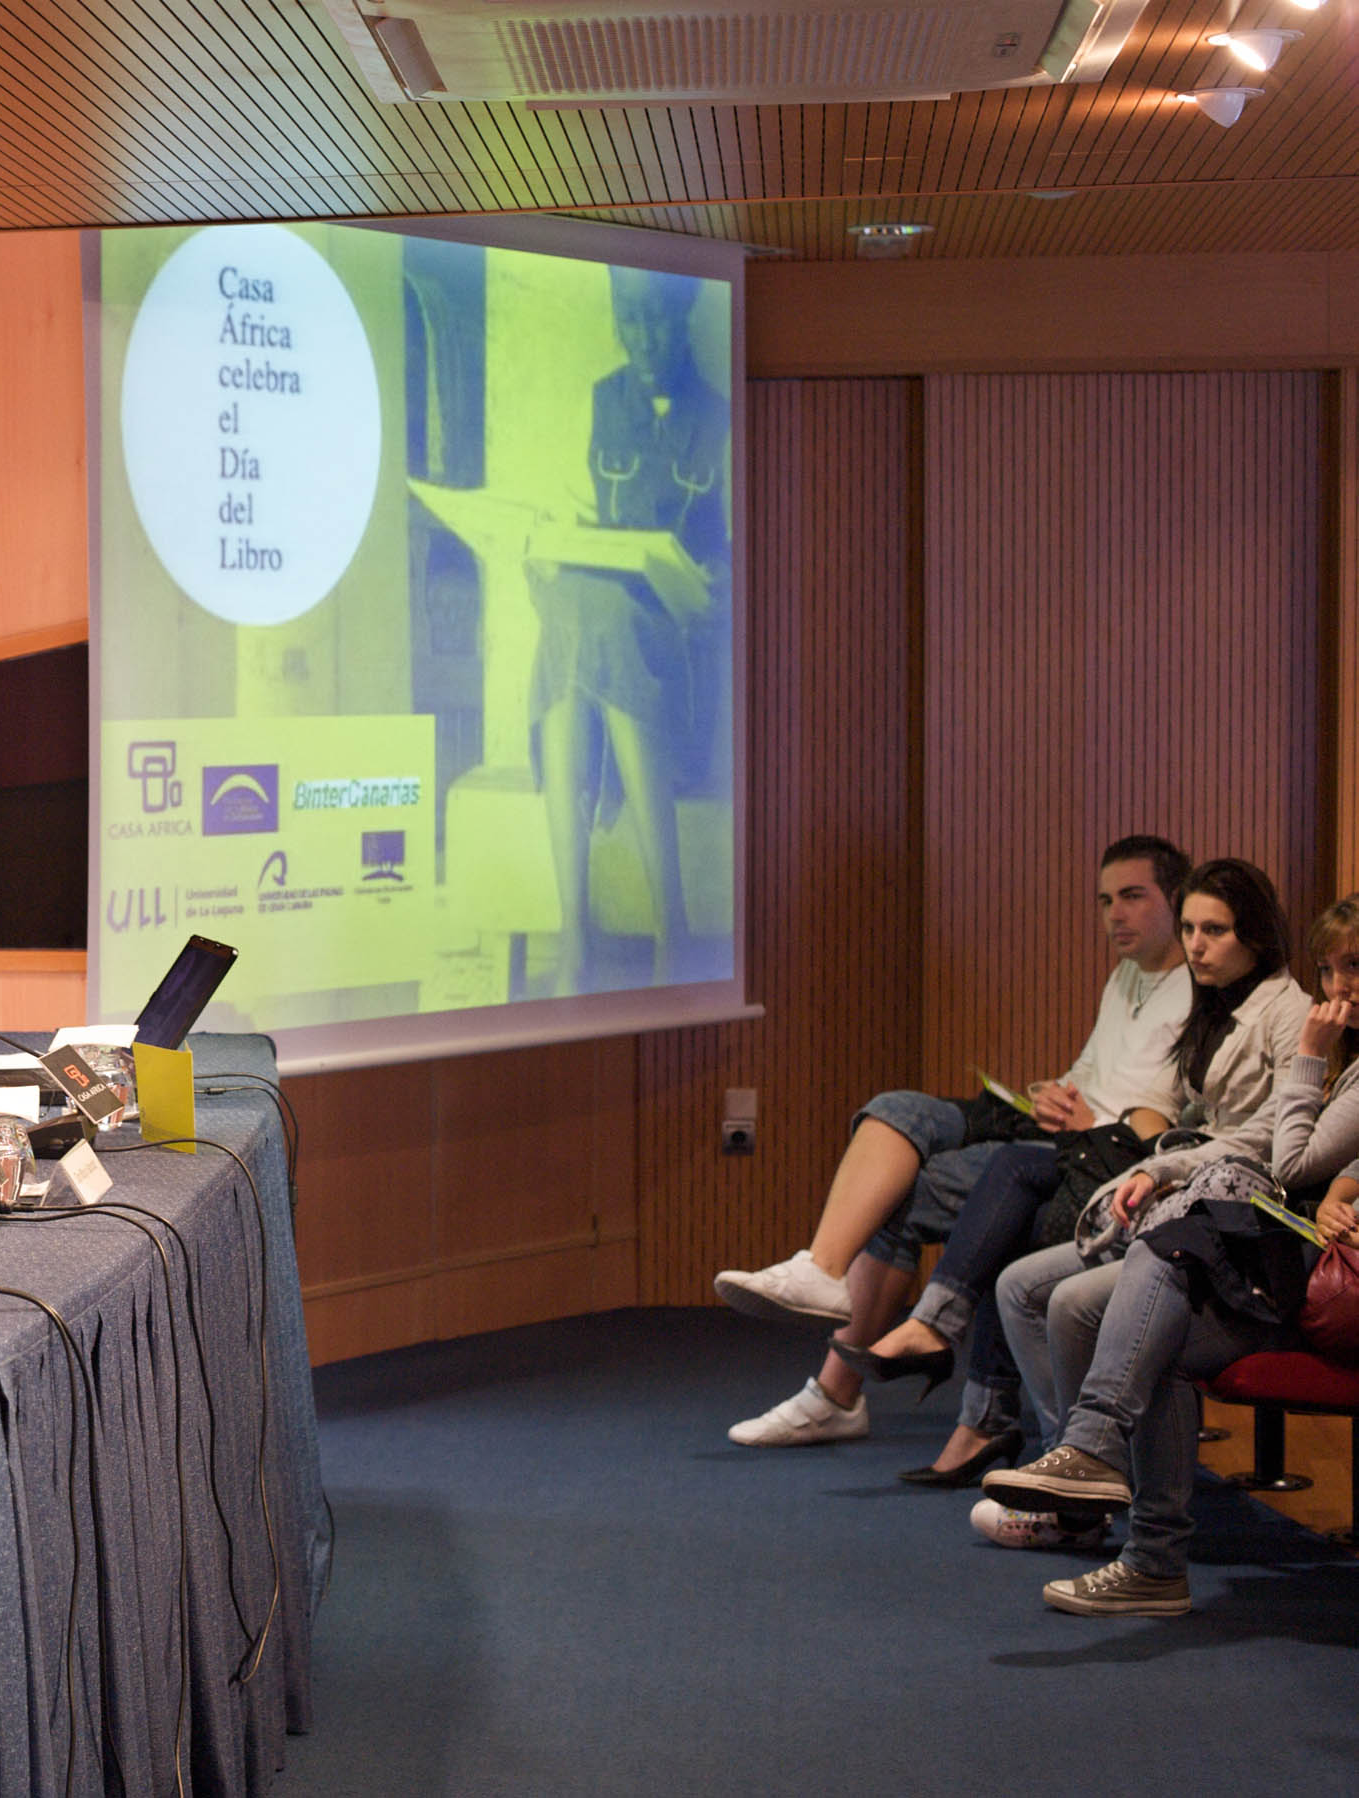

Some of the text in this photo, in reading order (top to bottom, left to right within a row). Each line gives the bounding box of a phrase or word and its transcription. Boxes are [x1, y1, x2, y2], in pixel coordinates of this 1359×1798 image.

[218, 266, 275, 303] Casa
[219, 303, 293, 350] África
[218, 358, 302, 394] celebra
[218, 402, 240, 434] el
[218, 447, 261, 481] Día
[218, 493, 254, 525] del
[219, 537, 284, 572] Libro
[107, 822, 144, 840] CASA
